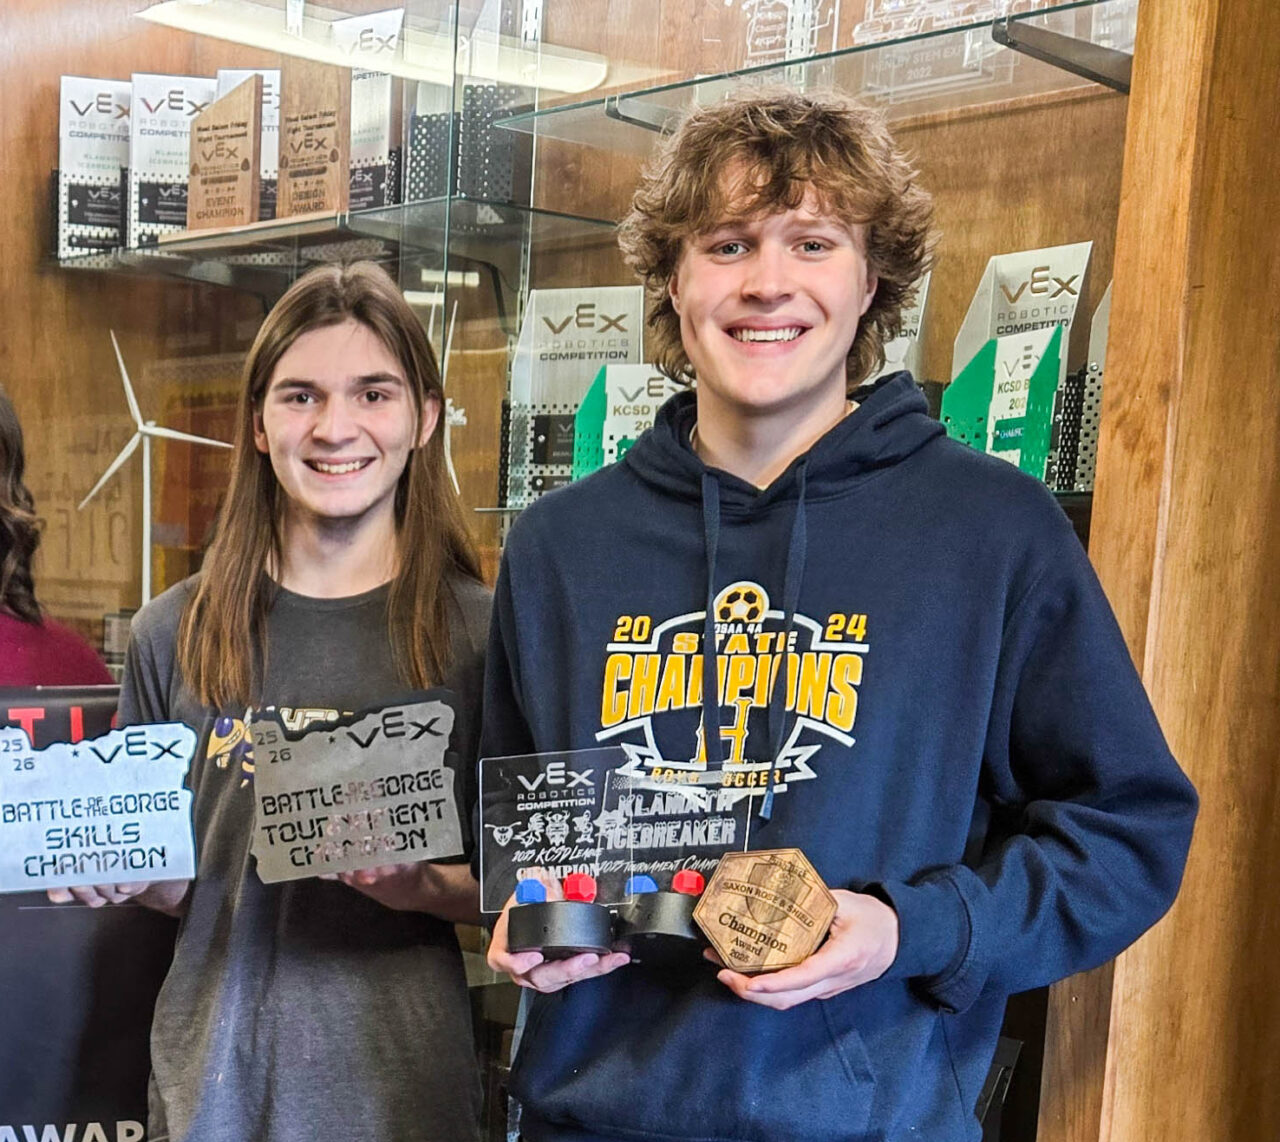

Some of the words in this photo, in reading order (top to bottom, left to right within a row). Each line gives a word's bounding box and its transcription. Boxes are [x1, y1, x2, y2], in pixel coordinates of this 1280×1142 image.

[140, 90, 210, 116] VEX
[202, 142, 239, 162] VEX
[290, 132, 327, 154] VEX
[206, 196, 236, 207] EVENT
[292, 188, 326, 201] DESIGN
[196, 207, 245, 220] CHAMPION
[999, 266, 1080, 304] VEX
[542, 303, 628, 335] VEX
[996, 318, 1071, 335] COMPETITIO
[539, 339, 629, 349] ROBOTICS
[540, 351, 629, 361] COMPETITION
[618, 377, 680, 403] VE
[997, 380, 1022, 395] KCSD
[613, 405, 651, 416] KCSD
[635, 421, 651, 431] 20
[613, 615, 652, 643] 20
[825, 613, 868, 642] 24
[747, 622, 763, 634] 4A
[601, 653, 863, 732] CHAMPIONS
[255, 730, 278, 746] 25
[346, 711, 444, 748] VEX
[1, 738, 23, 752] 25
[89, 730, 184, 764] VEX
[13, 757, 35, 771] 26
[269, 748, 292, 763] 26
[516, 762, 595, 791] VEX
[722, 769, 781, 788] OCCER
[261, 784, 344, 816] BATTLE
[370, 769, 444, 798] GORGE
[517, 788, 596, 800] ROBOTICS
[2, 798, 83, 823] BATTLE
[85, 805, 108, 818] THE
[110, 791, 180, 815] GORGE
[517, 798, 596, 811] COMPETITION
[617, 790, 733, 817] KLAMATH
[45, 822, 141, 850] SKILLS
[605, 818, 736, 849] ICEBREAKER
[24, 846, 167, 877] CHAMPION
[723, 882, 753, 895] SAXON
[754, 888, 778, 904] ROSE
[786, 904, 815, 928] SHIELD
[718, 912, 788, 954] Champion
[731, 937, 763, 956] Award
